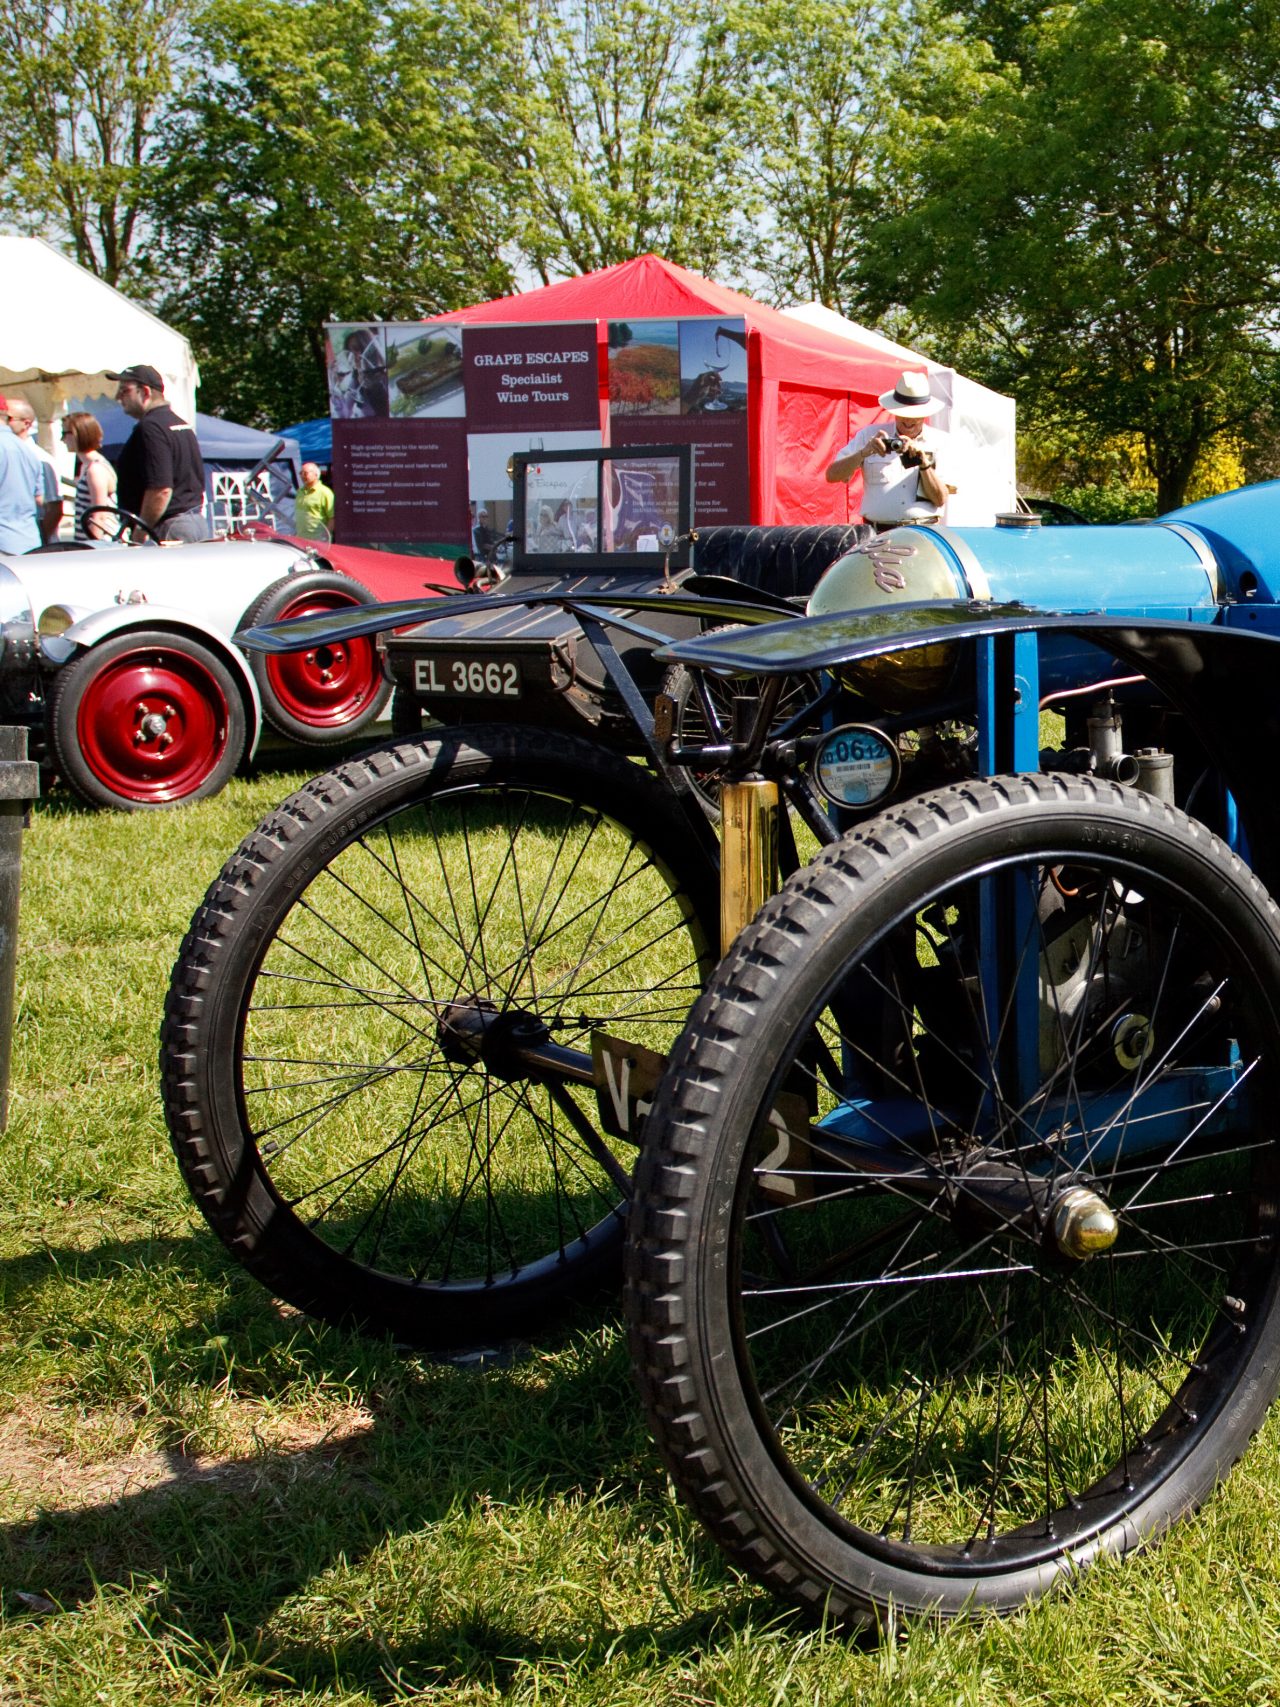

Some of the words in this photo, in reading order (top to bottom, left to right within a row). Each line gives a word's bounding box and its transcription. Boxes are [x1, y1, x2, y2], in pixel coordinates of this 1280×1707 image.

[473, 353, 523, 366] GRAPE
[526, 351, 590, 364] ESCAPES
[501, 373, 563, 388] Specialist
[496, 392, 529, 403] Wine
[531, 390, 569, 402] Tours
[414, 659, 446, 692] EL
[451, 660, 519, 695] 3662
[835, 739, 865, 762] 06
[866, 744, 885, 759] 12
